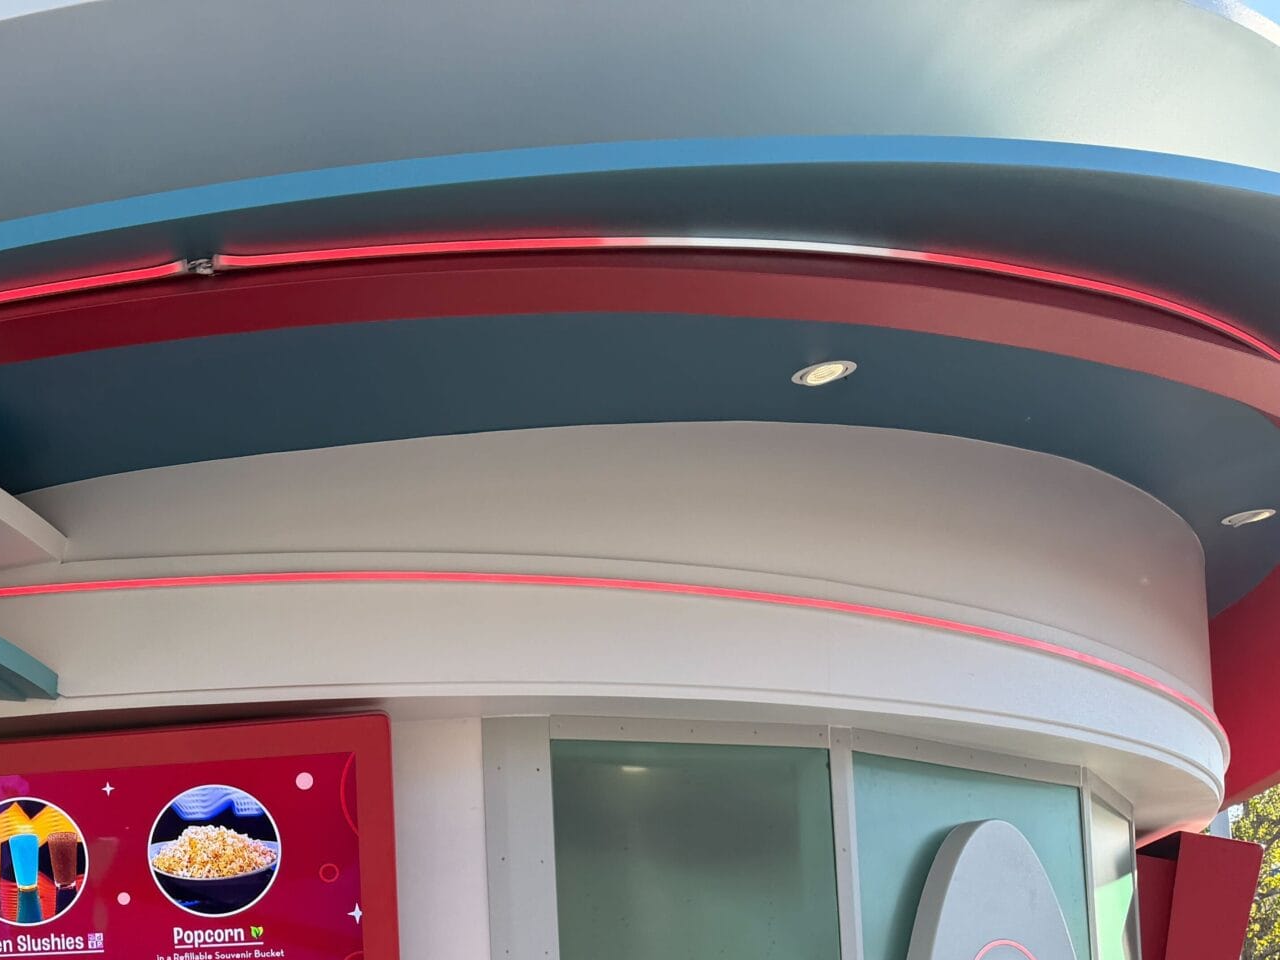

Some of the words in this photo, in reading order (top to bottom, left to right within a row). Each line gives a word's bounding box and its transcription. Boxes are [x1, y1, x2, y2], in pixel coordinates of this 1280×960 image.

[17, 933, 84, 952] Slushies
[173, 927, 244, 947] Popcorn
[173, 952, 213, 960] Refillable
[215, 950, 252, 959] Souvenir
[254, 949, 285, 958] Bucket
